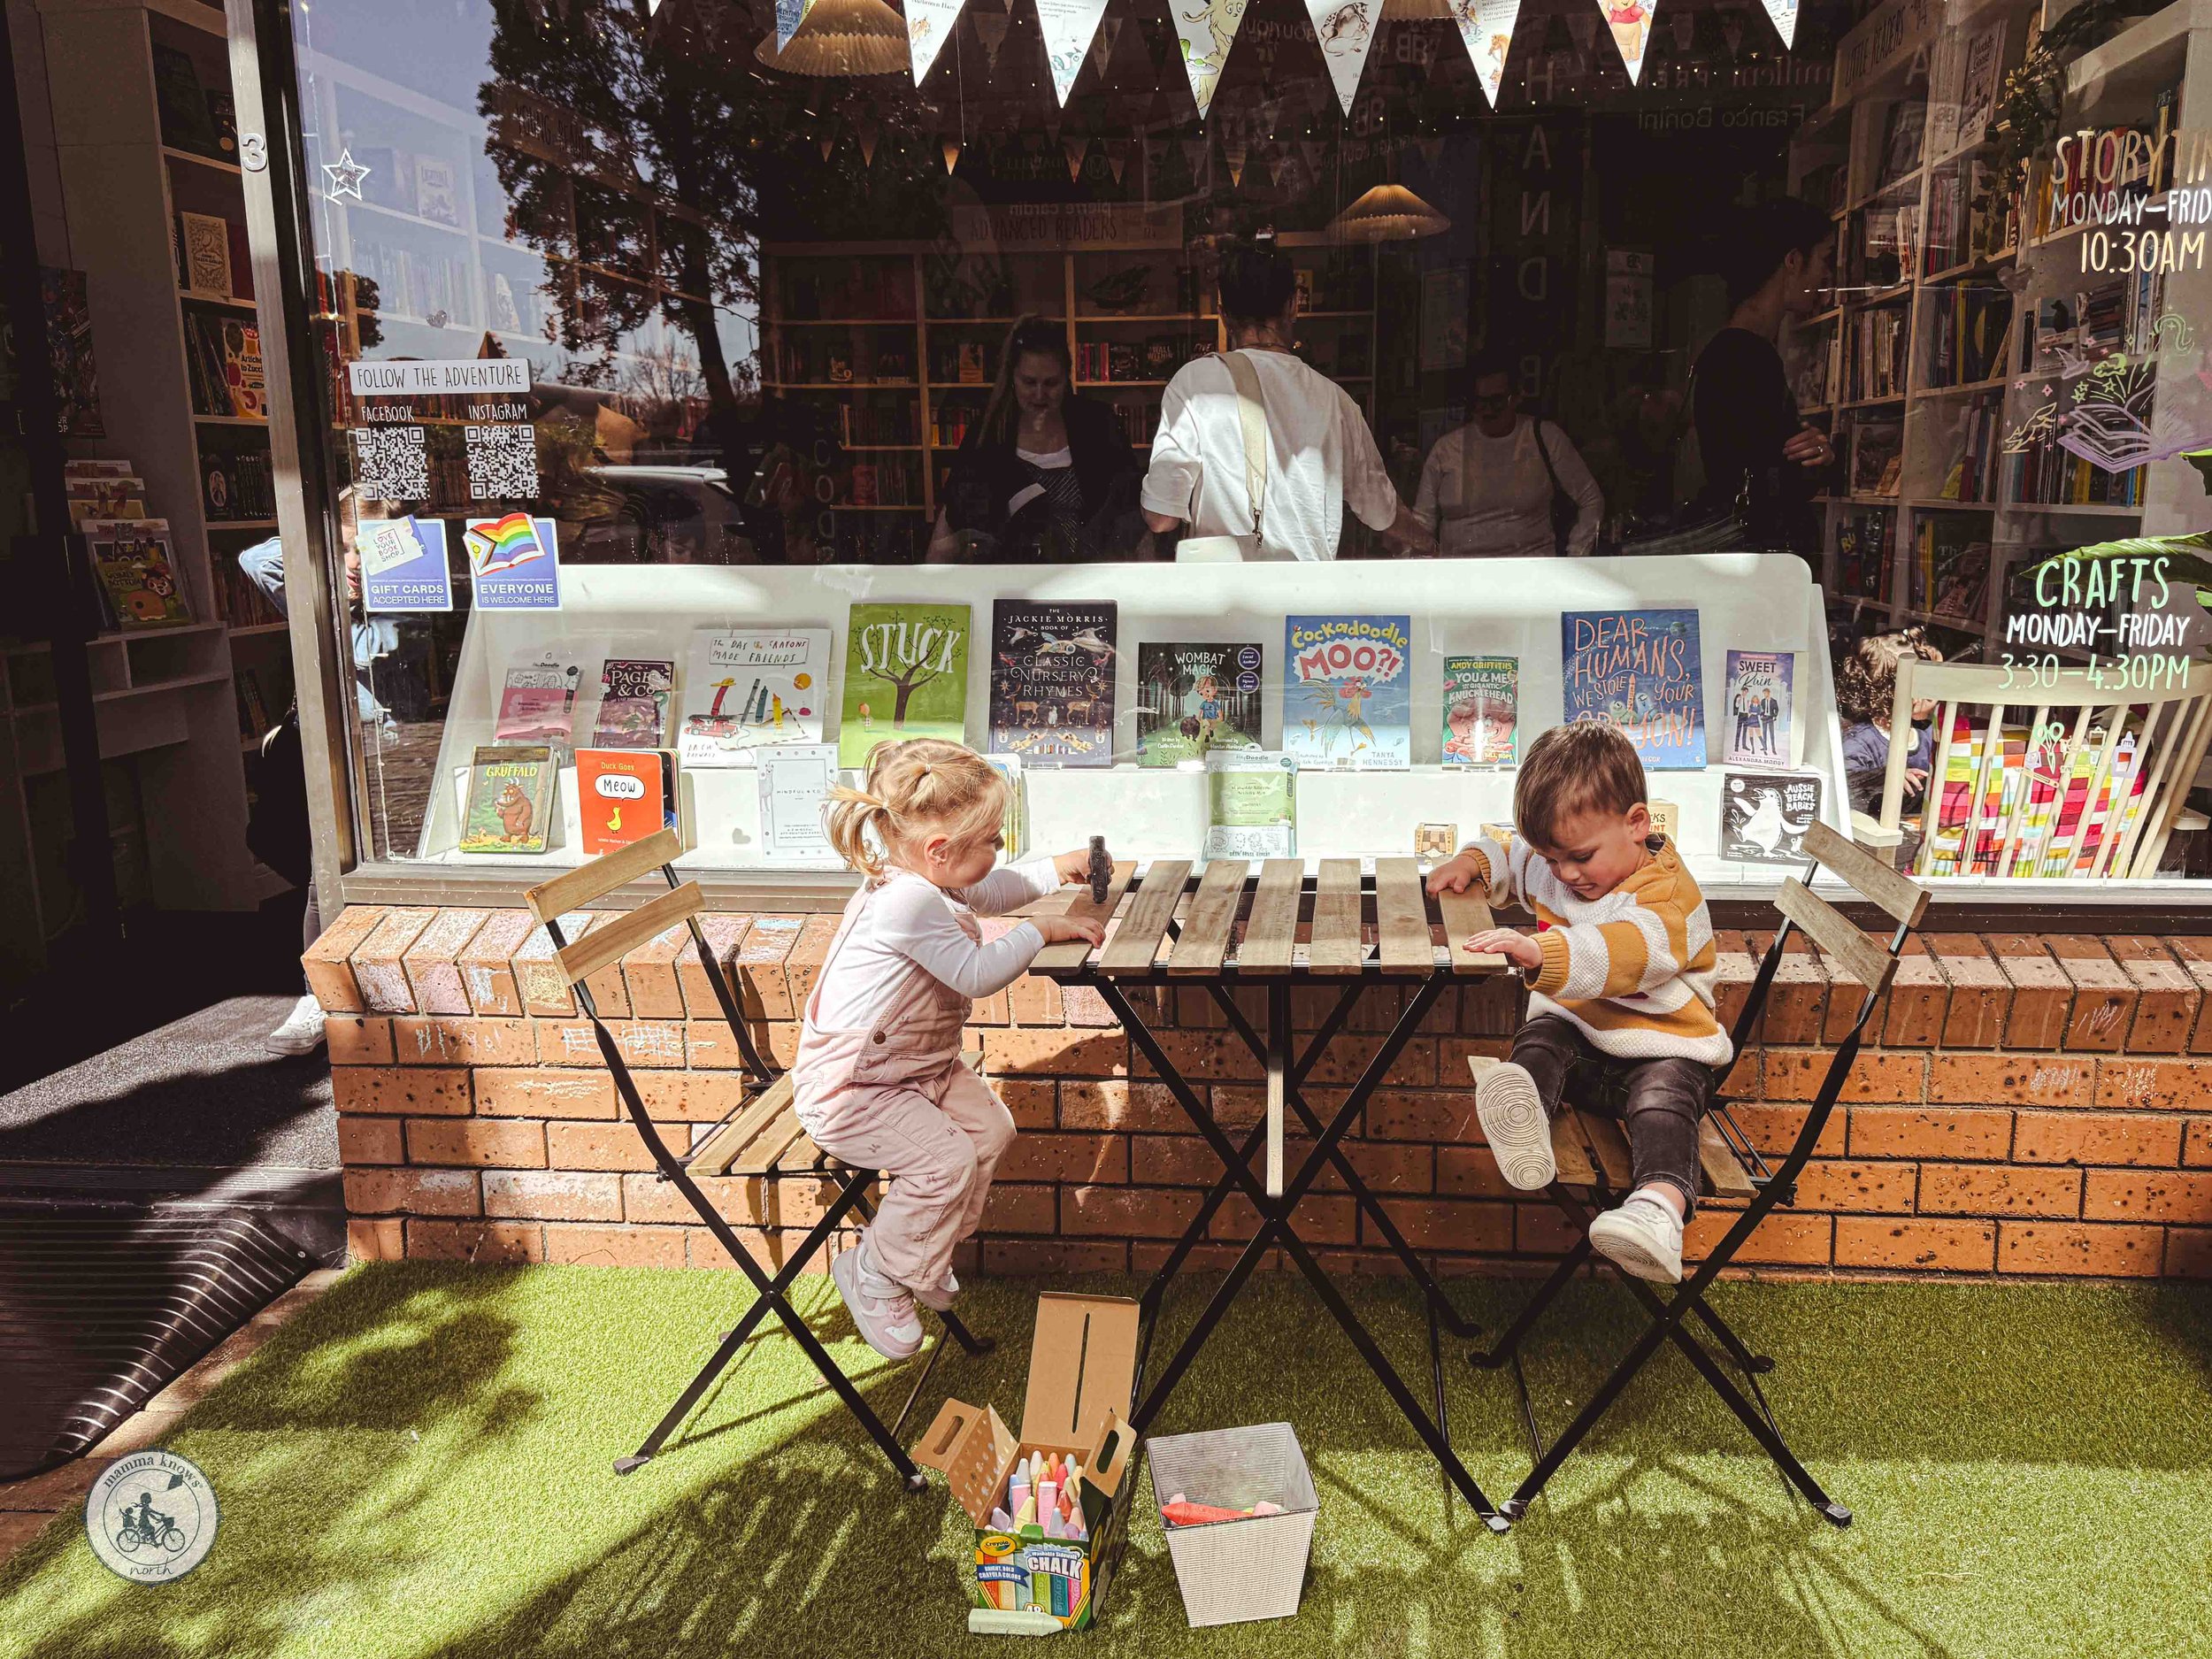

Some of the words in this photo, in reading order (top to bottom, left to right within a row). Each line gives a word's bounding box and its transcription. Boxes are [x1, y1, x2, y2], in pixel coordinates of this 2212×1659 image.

[241, 132, 268, 172] 3
[1055, 217, 1118, 241] READERS
[2081, 231, 2205, 274] 10:30AM
[357, 368, 405, 388] FOLLOW
[414, 367, 438, 388] THE
[445, 365, 522, 388] ADVENTURE
[361, 405, 415, 422] FACEBOOK
[468, 403, 527, 421] INSTAGRAM
[371, 584, 398, 595] GIFT
[403, 584, 444, 594] CARDS
[480, 584, 554, 594] EVERYONE
[2036, 557, 2169, 610] CRAFTS
[373, 595, 420, 604] ACCEPTED
[422, 595, 445, 604] HERE
[1575, 615, 1648, 651] DEAR
[731, 641, 748, 650] DAY
[859, 622, 961, 674] STUCK
[712, 650, 740, 661] MADE
[749, 652, 796, 663] FRIENDS
[1023, 655, 1086, 667] CLASSIC
[1175, 652, 1226, 665] WOMBAT
[1299, 643, 1401, 680] MOO?!
[1574, 635, 1691, 688] HUMANS,
[1182, 664, 1217, 675] MAGIC
[1473, 661, 1512, 670] GRIFFITHS
[1739, 661, 1777, 673] SWEET
[1010, 667, 1097, 682] NURSERY
[1455, 673, 1479, 683] YOU
[1480, 672, 1490, 682] &
[1491, 673, 1509, 684] ME
[618, 684, 631, 697] &
[1023, 685, 1083, 697] RHYMES
[1448, 688, 1514, 705] KNUCKLEHEAD
[1572, 688, 1594, 708] WE
[1594, 676, 1628, 701] STOLE
[1655, 682, 1694, 703] YOUR
[1575, 706, 1696, 750] YON!
[486, 765, 538, 777] GRUFFALO
[1785, 793, 1816, 803] BEACH
[1027, 1556, 1083, 1580] CHALK
